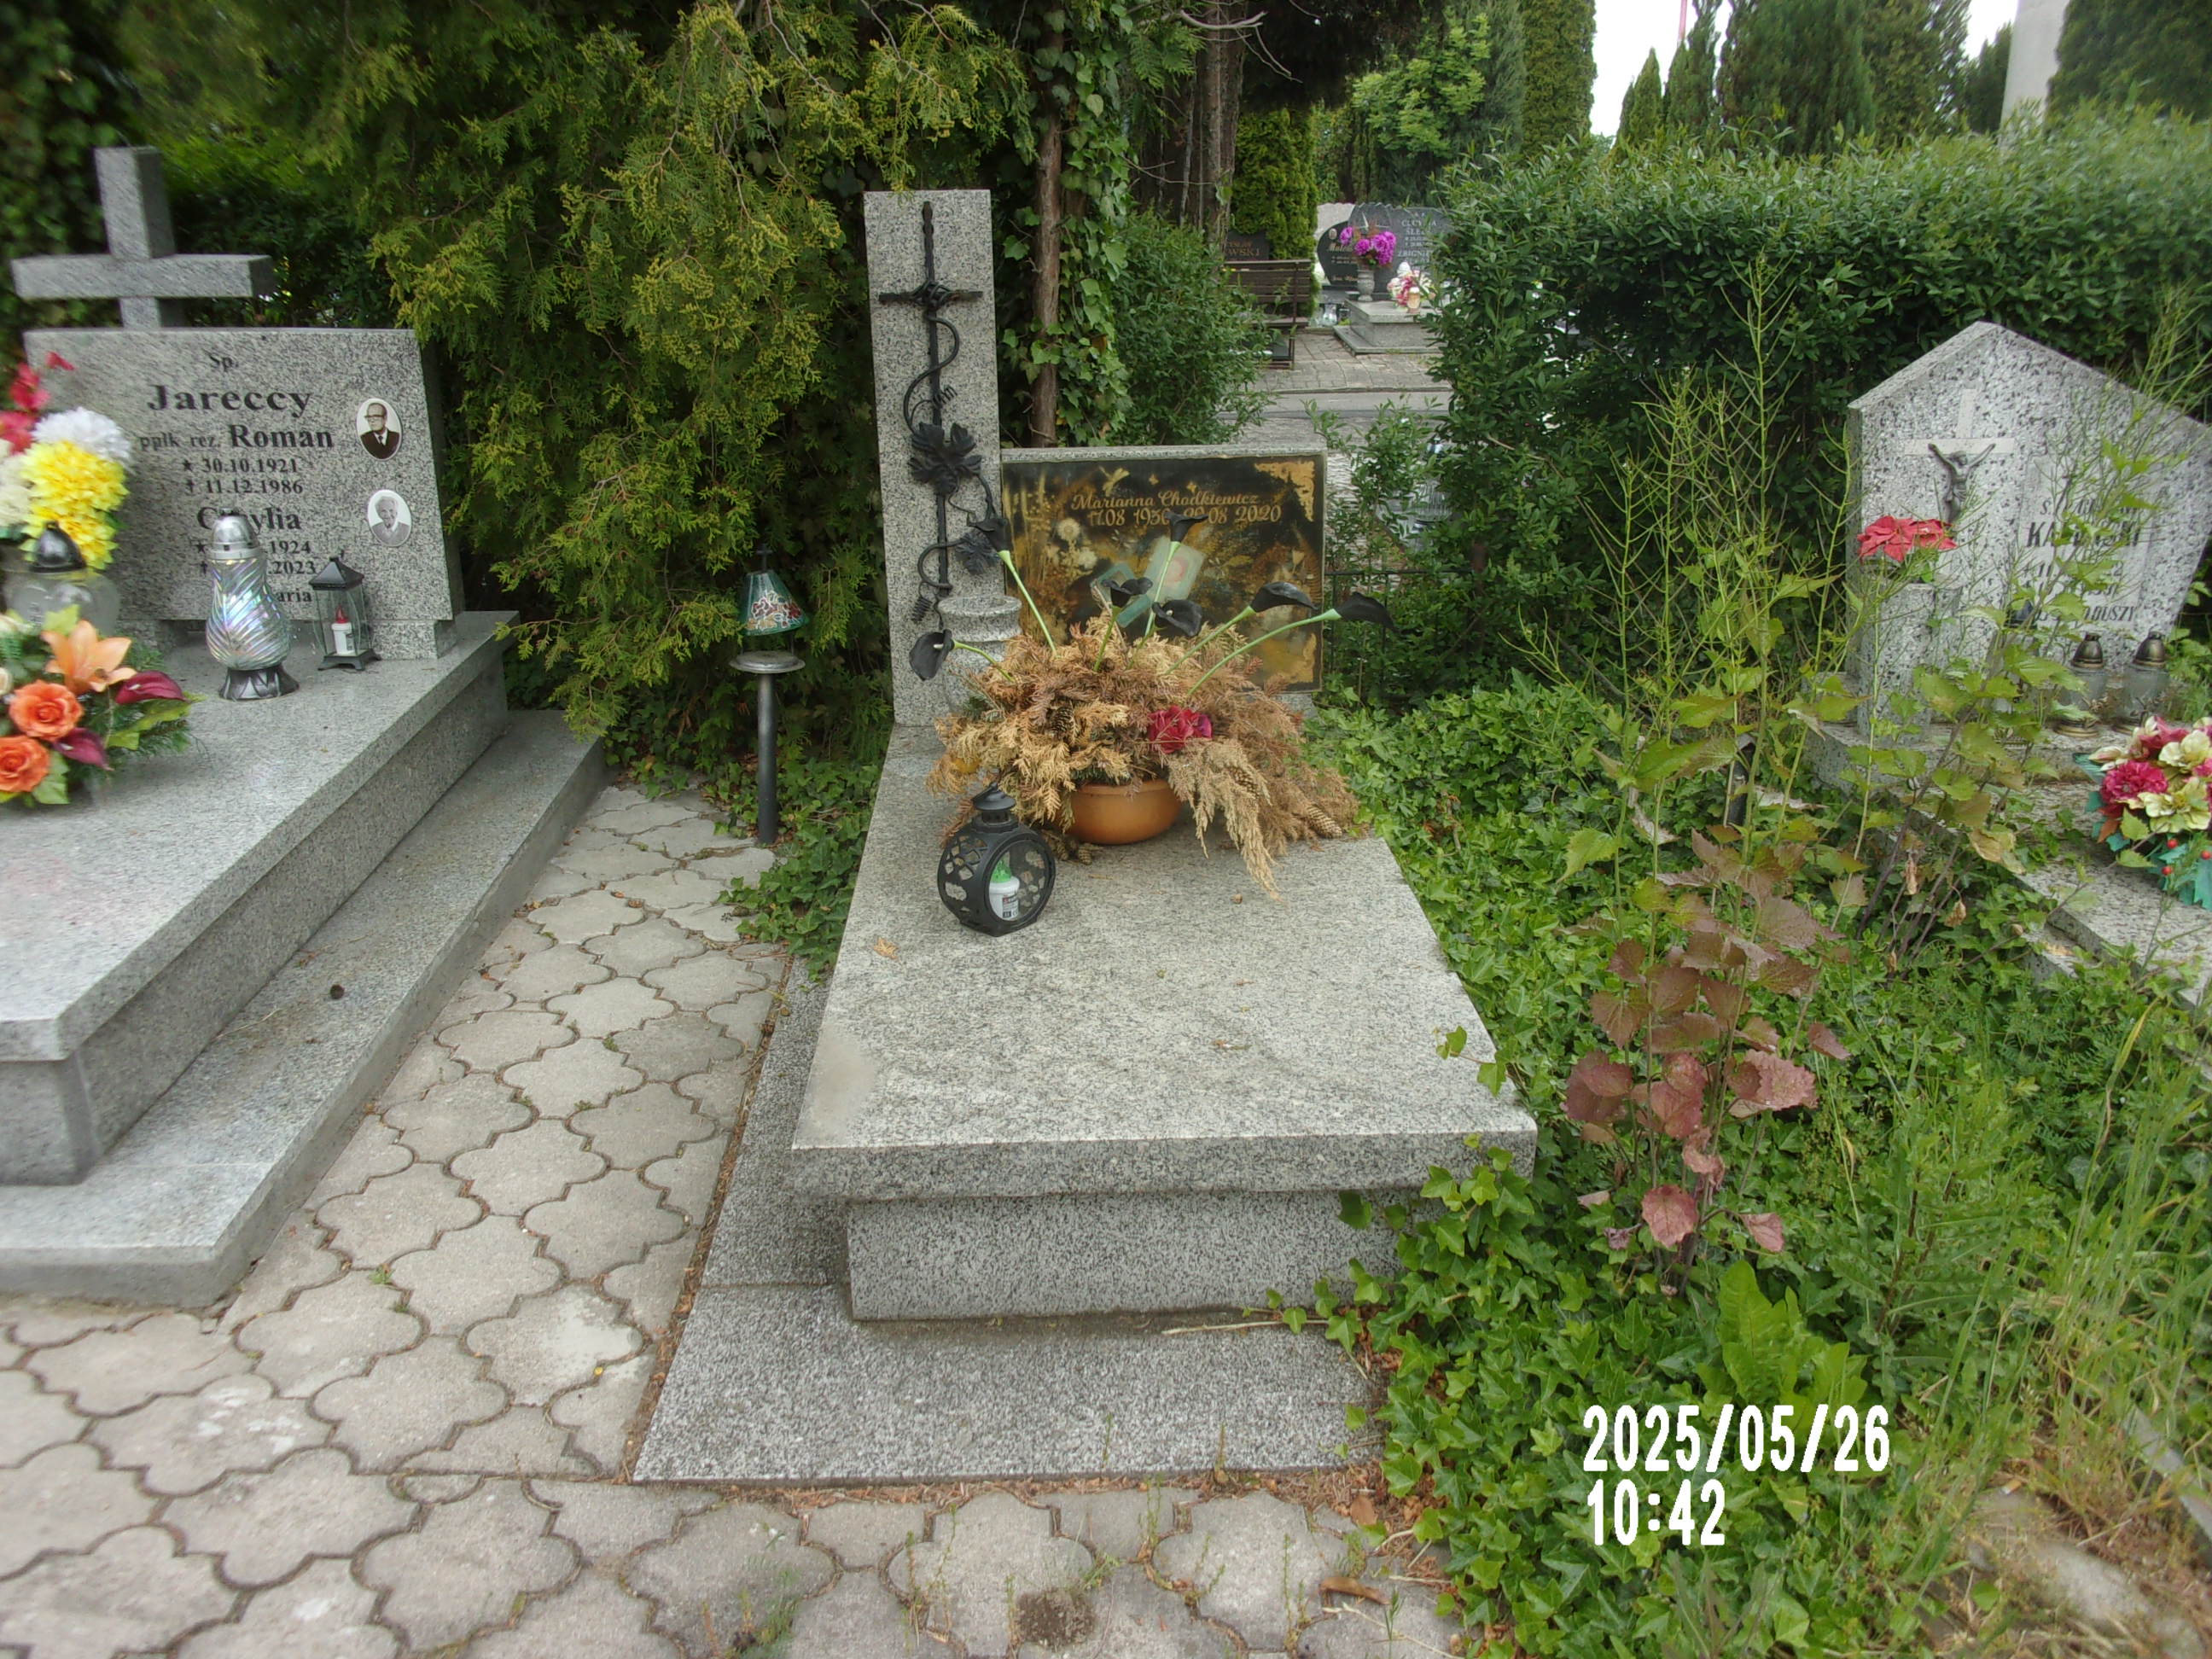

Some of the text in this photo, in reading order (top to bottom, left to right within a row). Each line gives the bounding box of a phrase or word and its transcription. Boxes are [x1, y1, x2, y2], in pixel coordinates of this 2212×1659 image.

[147, 384, 312, 418] Jareccy
[229, 423, 334, 449] Roman
[201, 457, 299, 474] 30.10.1921
[206, 479, 304, 494] 11.12.1986
[1071, 490, 1260, 510] Marianna Chodkiewicz
[197, 505, 302, 536] Cylia
[1235, 504, 1282, 523] 2020
[276, 587, 312, 602] aria
